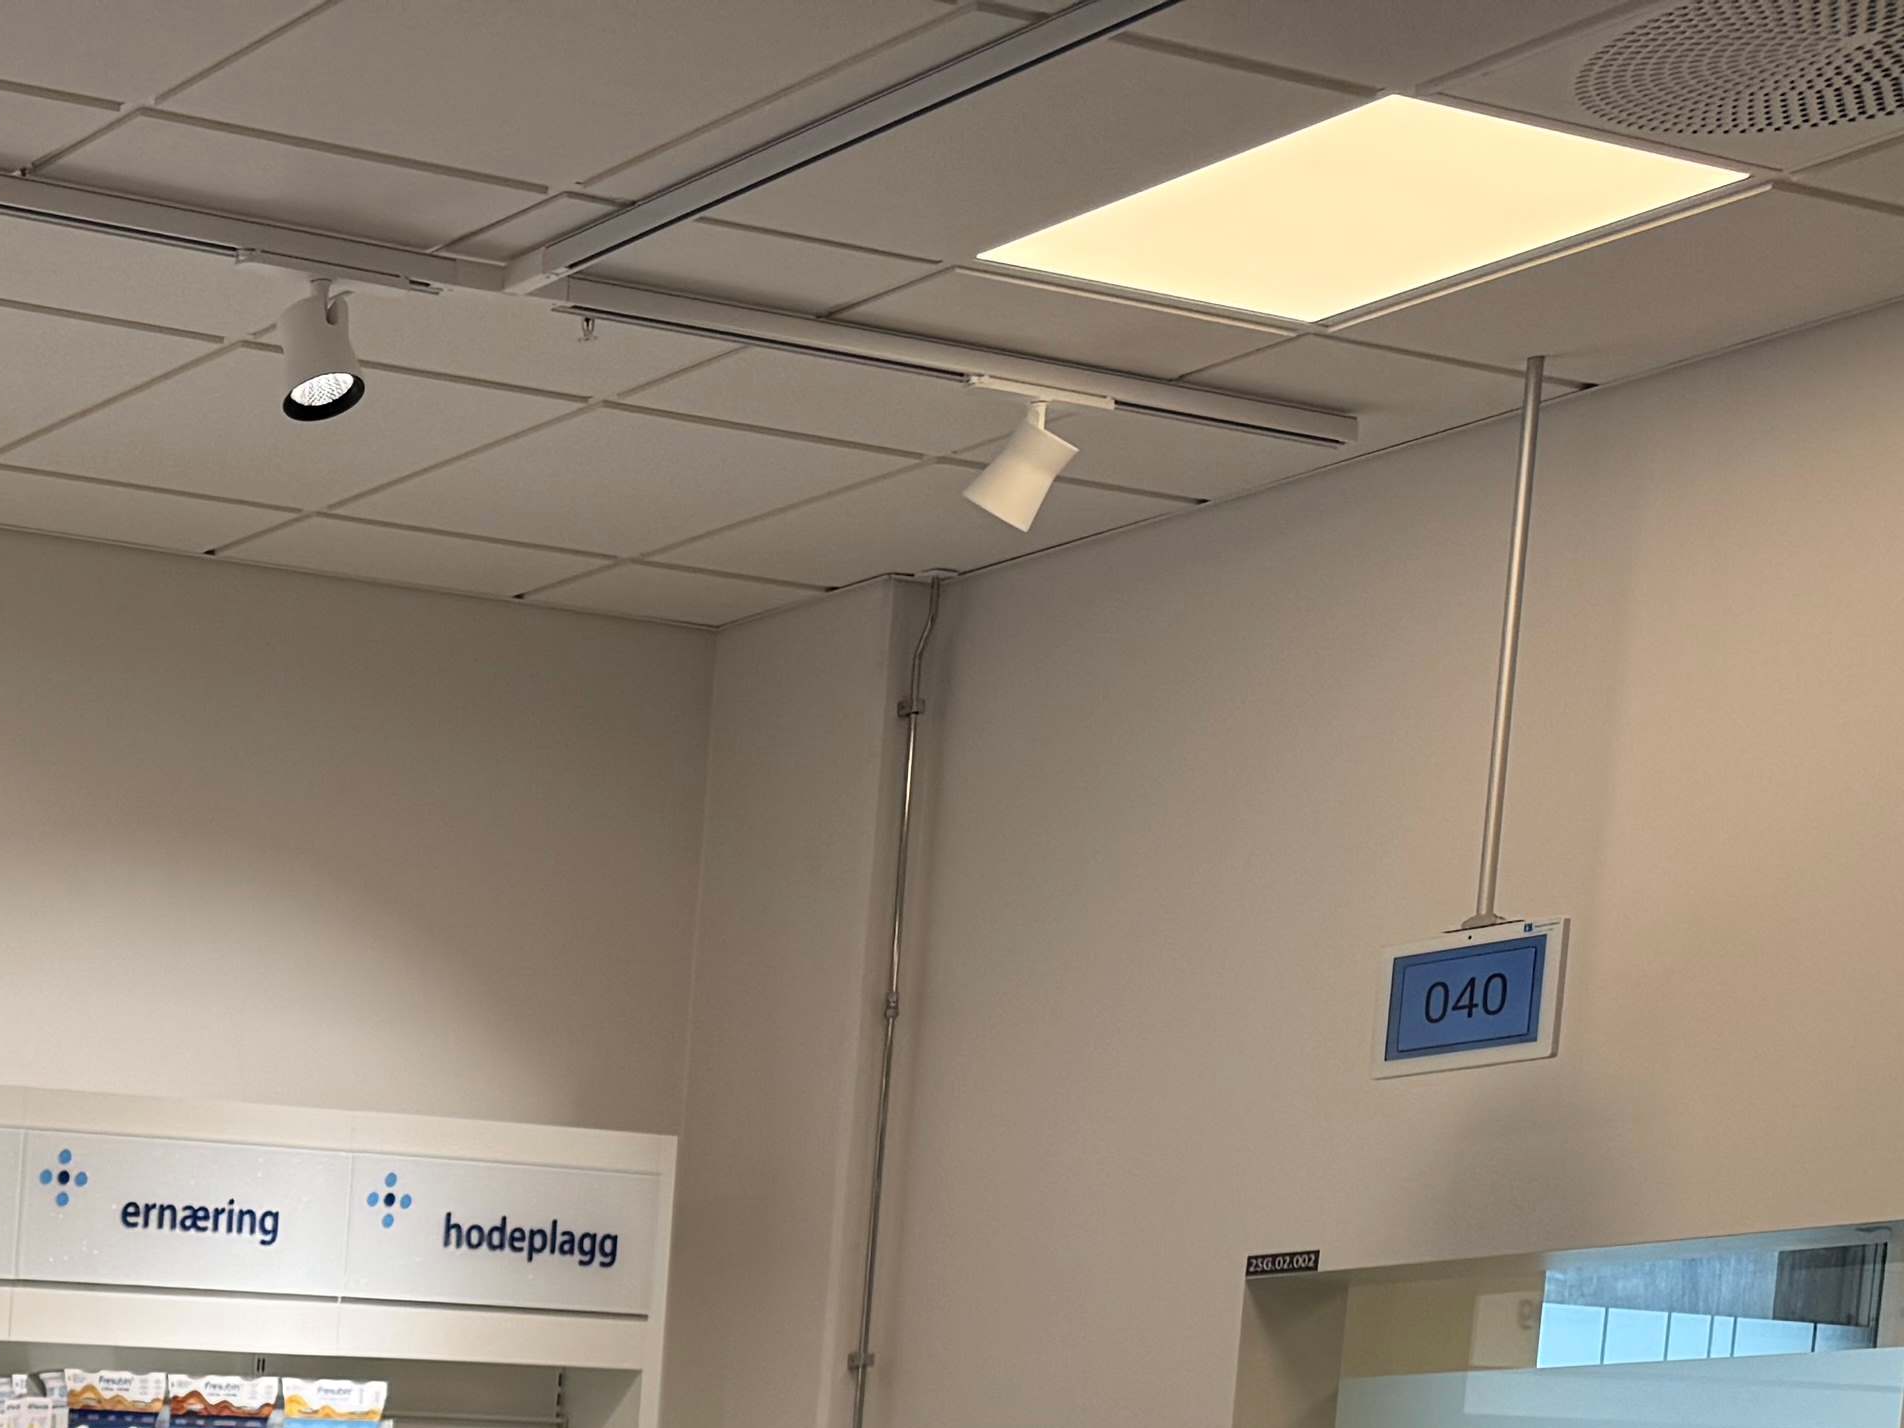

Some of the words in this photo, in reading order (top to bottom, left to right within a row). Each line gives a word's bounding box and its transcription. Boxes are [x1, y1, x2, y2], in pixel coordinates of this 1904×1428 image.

[1423, 972, 1508, 1025] 040
[121, 1195, 280, 1245] ernæring
[442, 1212, 618, 1268] hodeplagg
